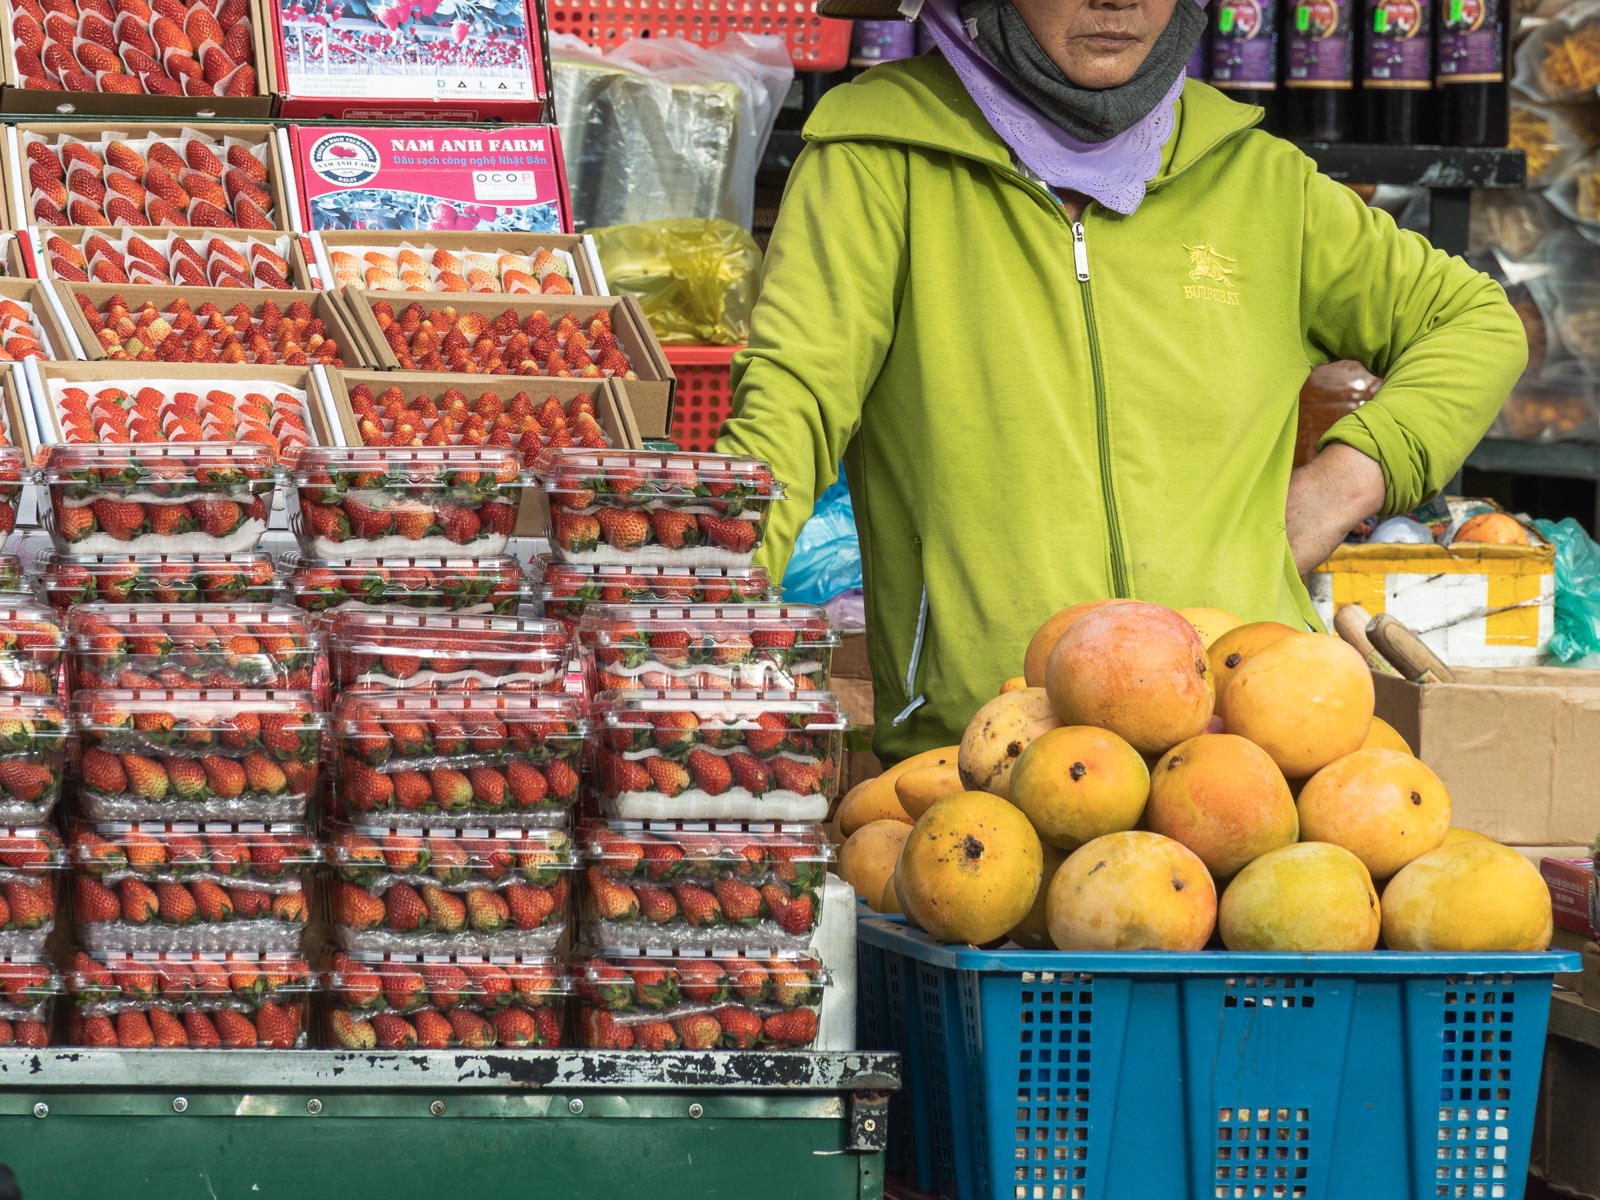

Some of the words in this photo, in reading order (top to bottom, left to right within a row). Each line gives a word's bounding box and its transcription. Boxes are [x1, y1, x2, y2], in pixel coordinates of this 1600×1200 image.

[345, 138, 374, 160] TECHNOLOGY
[390, 139, 435, 152] NAM
[439, 139, 484, 152] ANH
[488, 139, 545, 152] FARM
[393, 155, 415, 165] Dâu
[417, 155, 440, 166] sạch
[442, 155, 467, 166] công
[469, 155, 496, 167] nghệ
[499, 155, 525, 167] Nhật
[527, 155, 547, 165] Bản
[476, 173, 531, 183] OCOP
[1183, 285, 1240, 305] BURBERRY
